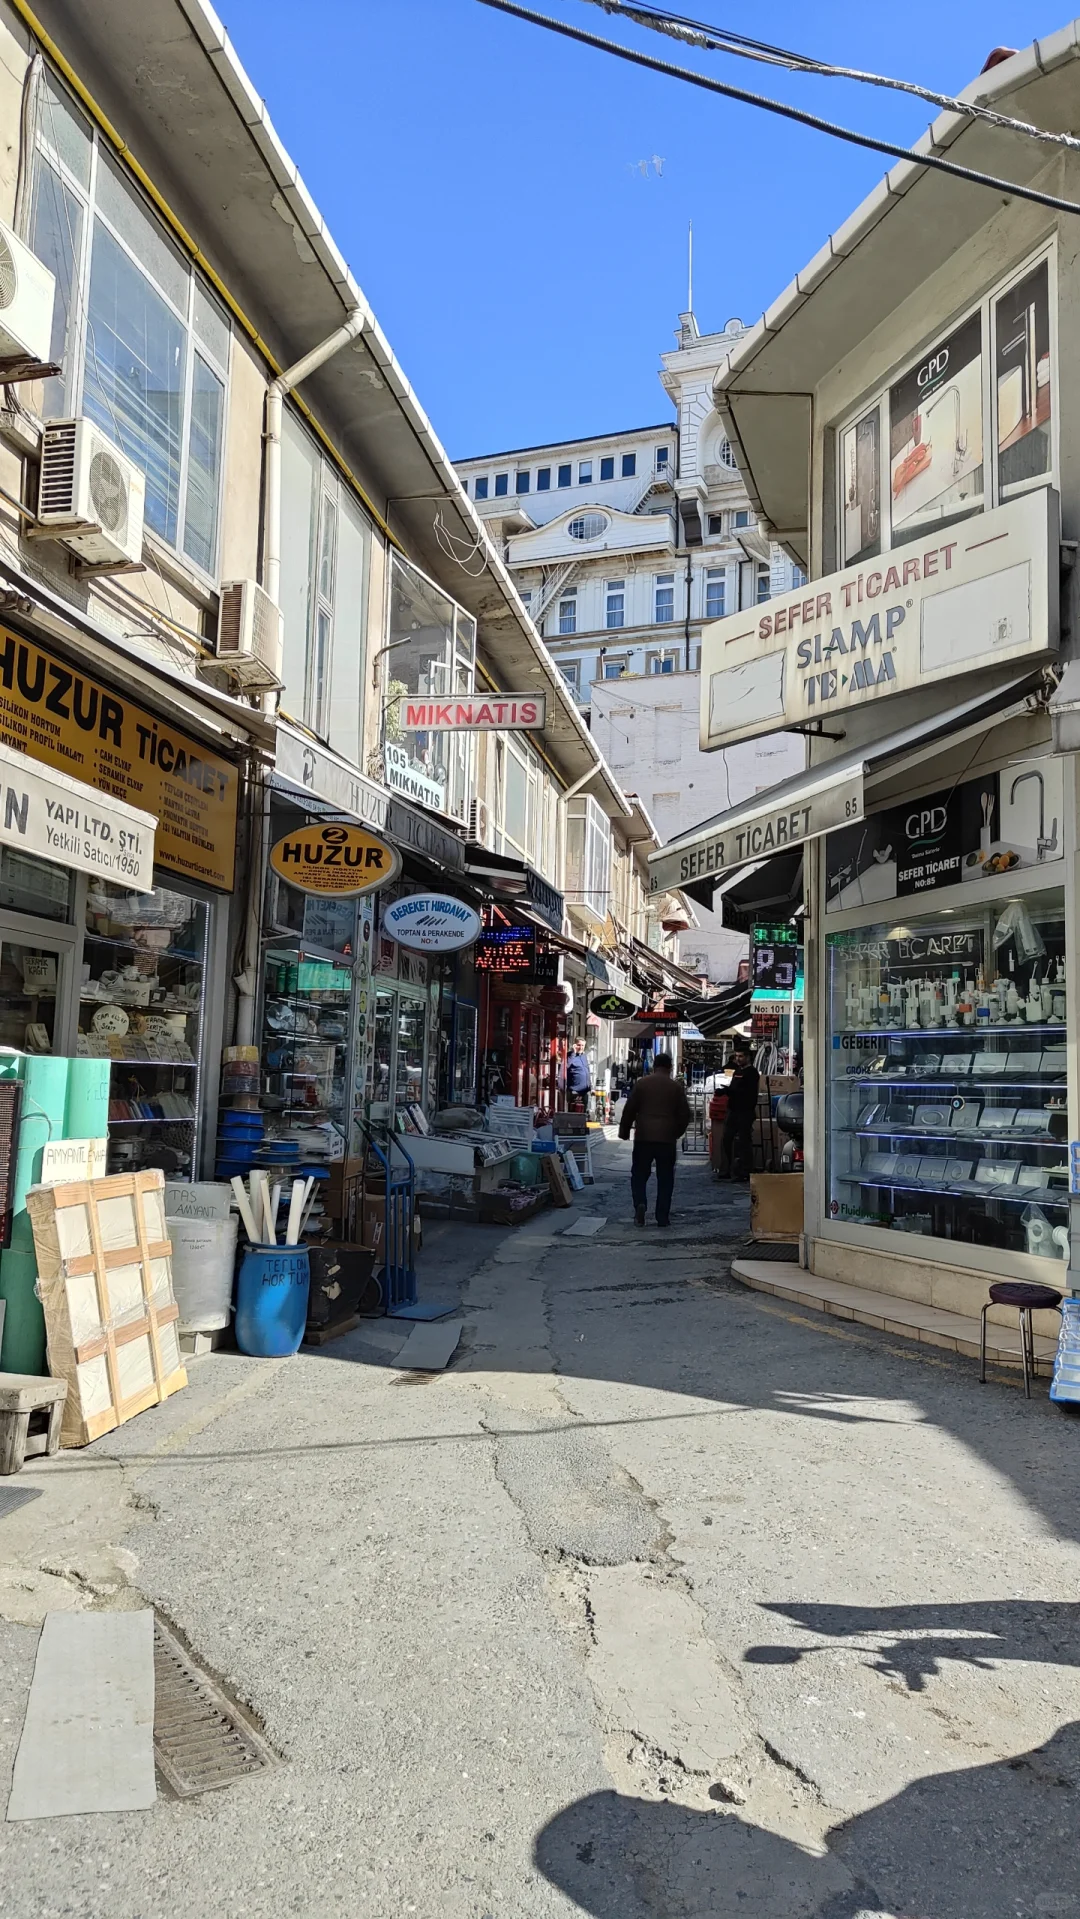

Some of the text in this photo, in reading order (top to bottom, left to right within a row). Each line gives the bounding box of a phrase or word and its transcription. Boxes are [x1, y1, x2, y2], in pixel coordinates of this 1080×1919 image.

[917, 349, 949, 387] GPD
[758, 542, 958, 640] SEFER TİCARET
[797, 604, 907, 669] SIAMP
[0, 696, 61, 737] SİLİKON HORTUM
[0, 636, 124, 749] HUZUR
[136, 722, 229, 802] TİCARET
[406, 702, 537, 726] MIKNATIS
[0, 731, 28, 753] MYANT
[30, 728, 55, 751] PROFİL
[57, 739, 84, 764] İMALATI
[99, 749, 132, 772] CAM ELYAF
[386, 745, 406, 769] 105
[98, 776, 128, 800] YÜN KEÇE
[99, 763, 144, 793] SERAMİK ELYAF
[389, 768, 441, 808] MIKNATIS
[350, 781, 393, 832] HUZUR
[45, 798, 79, 829] YAPI
[84, 815, 114, 844] LTD.
[118, 830, 143, 854] ŞTİ.
[326, 829, 344, 842] 2
[905, 807, 948, 839] GPD
[46, 824, 140, 877] Yetkili Satıcı/1950
[680, 797, 858, 881] SEFER TİCARET 85
[159, 849, 225, 882] www.huzurticaret.com
[282, 843, 384, 869] HUZUR
[898, 856, 960, 882] SEFER TİCARET
[914, 877, 936, 889] NO:85
[390, 900, 472, 923] BEREKET HIRDAVAT
[397, 928, 421, 937] TOPTAN
[428, 930, 465, 938] PERAKENDE
[754, 1005, 768, 1013] No:
[770, 1005, 785, 1013] 101
[175, 1204, 217, 1217] AMYANT
[262, 1272, 309, 1287] HORTUM
